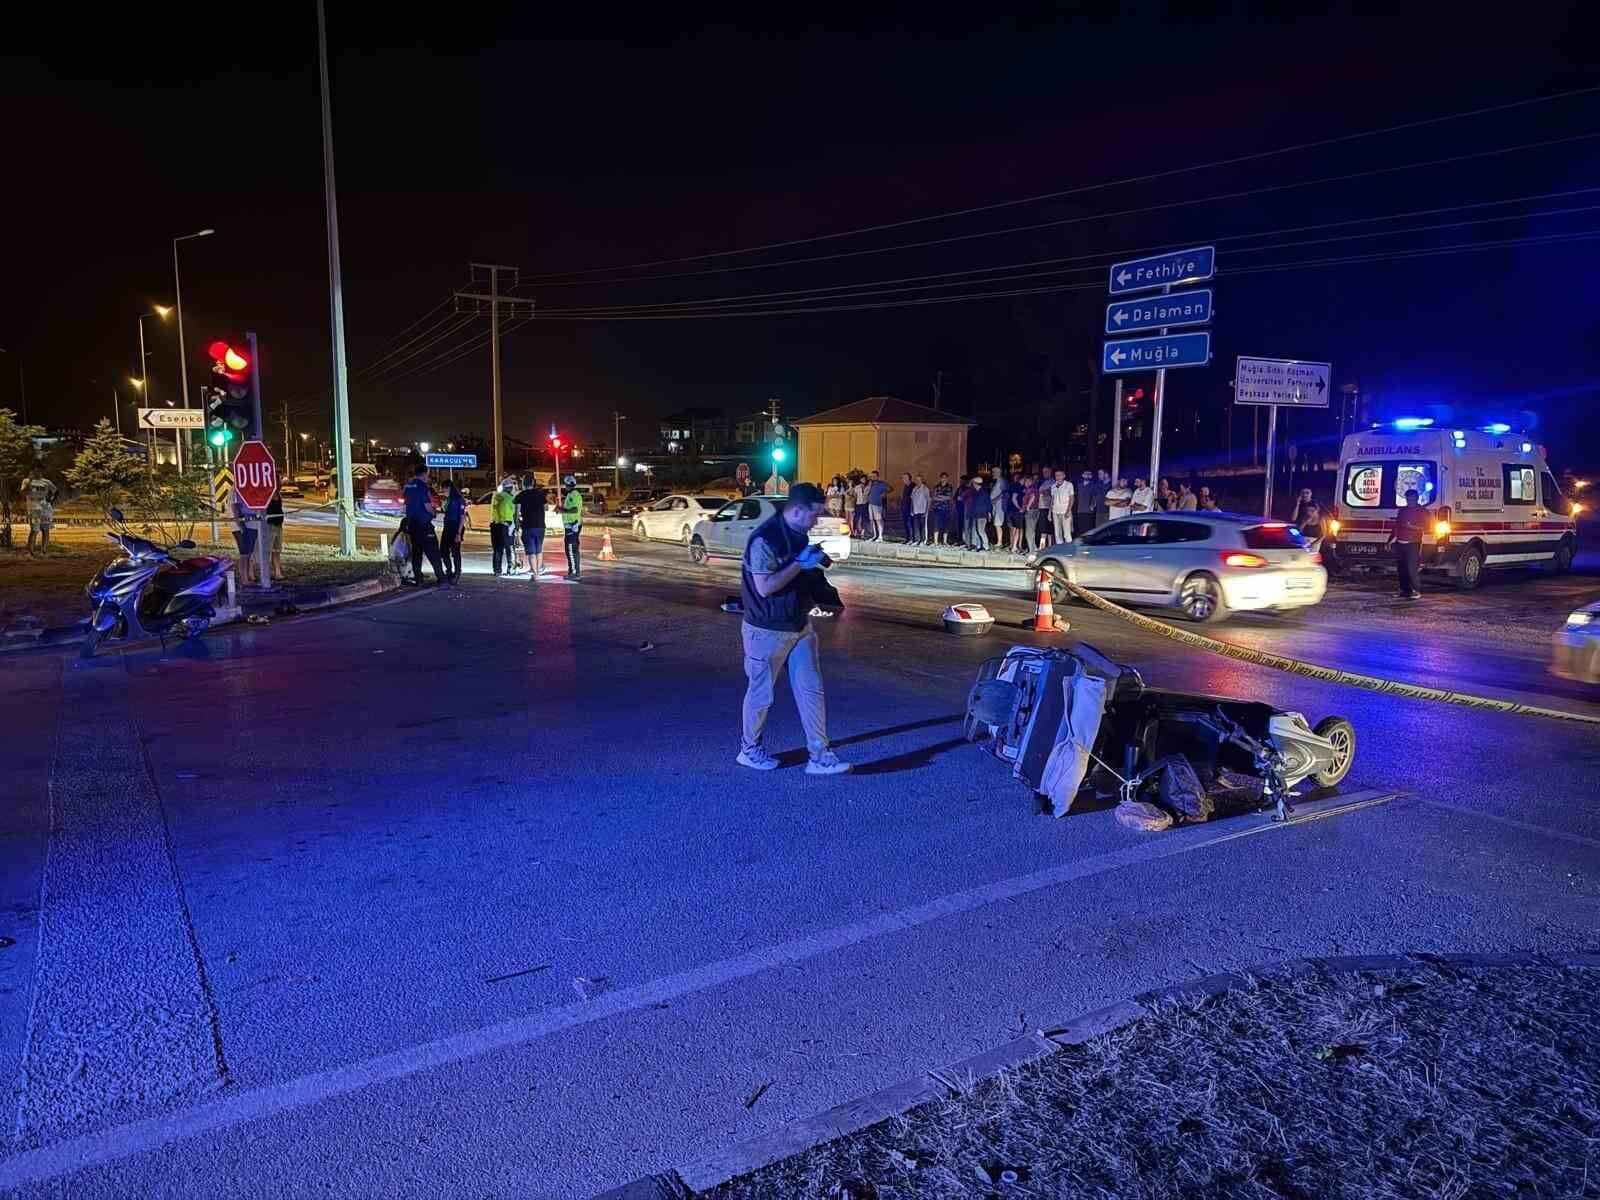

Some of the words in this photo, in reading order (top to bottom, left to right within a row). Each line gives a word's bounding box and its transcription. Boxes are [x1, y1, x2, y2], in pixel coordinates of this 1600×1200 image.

[1136, 261, 1195, 281] Fethiye
[1133, 303, 1204, 322] Dalaman
[1130, 345, 1179, 362] Muğla
[1357, 446, 1421, 456] AMBULANS
[237, 462, 273, 488] DUR
